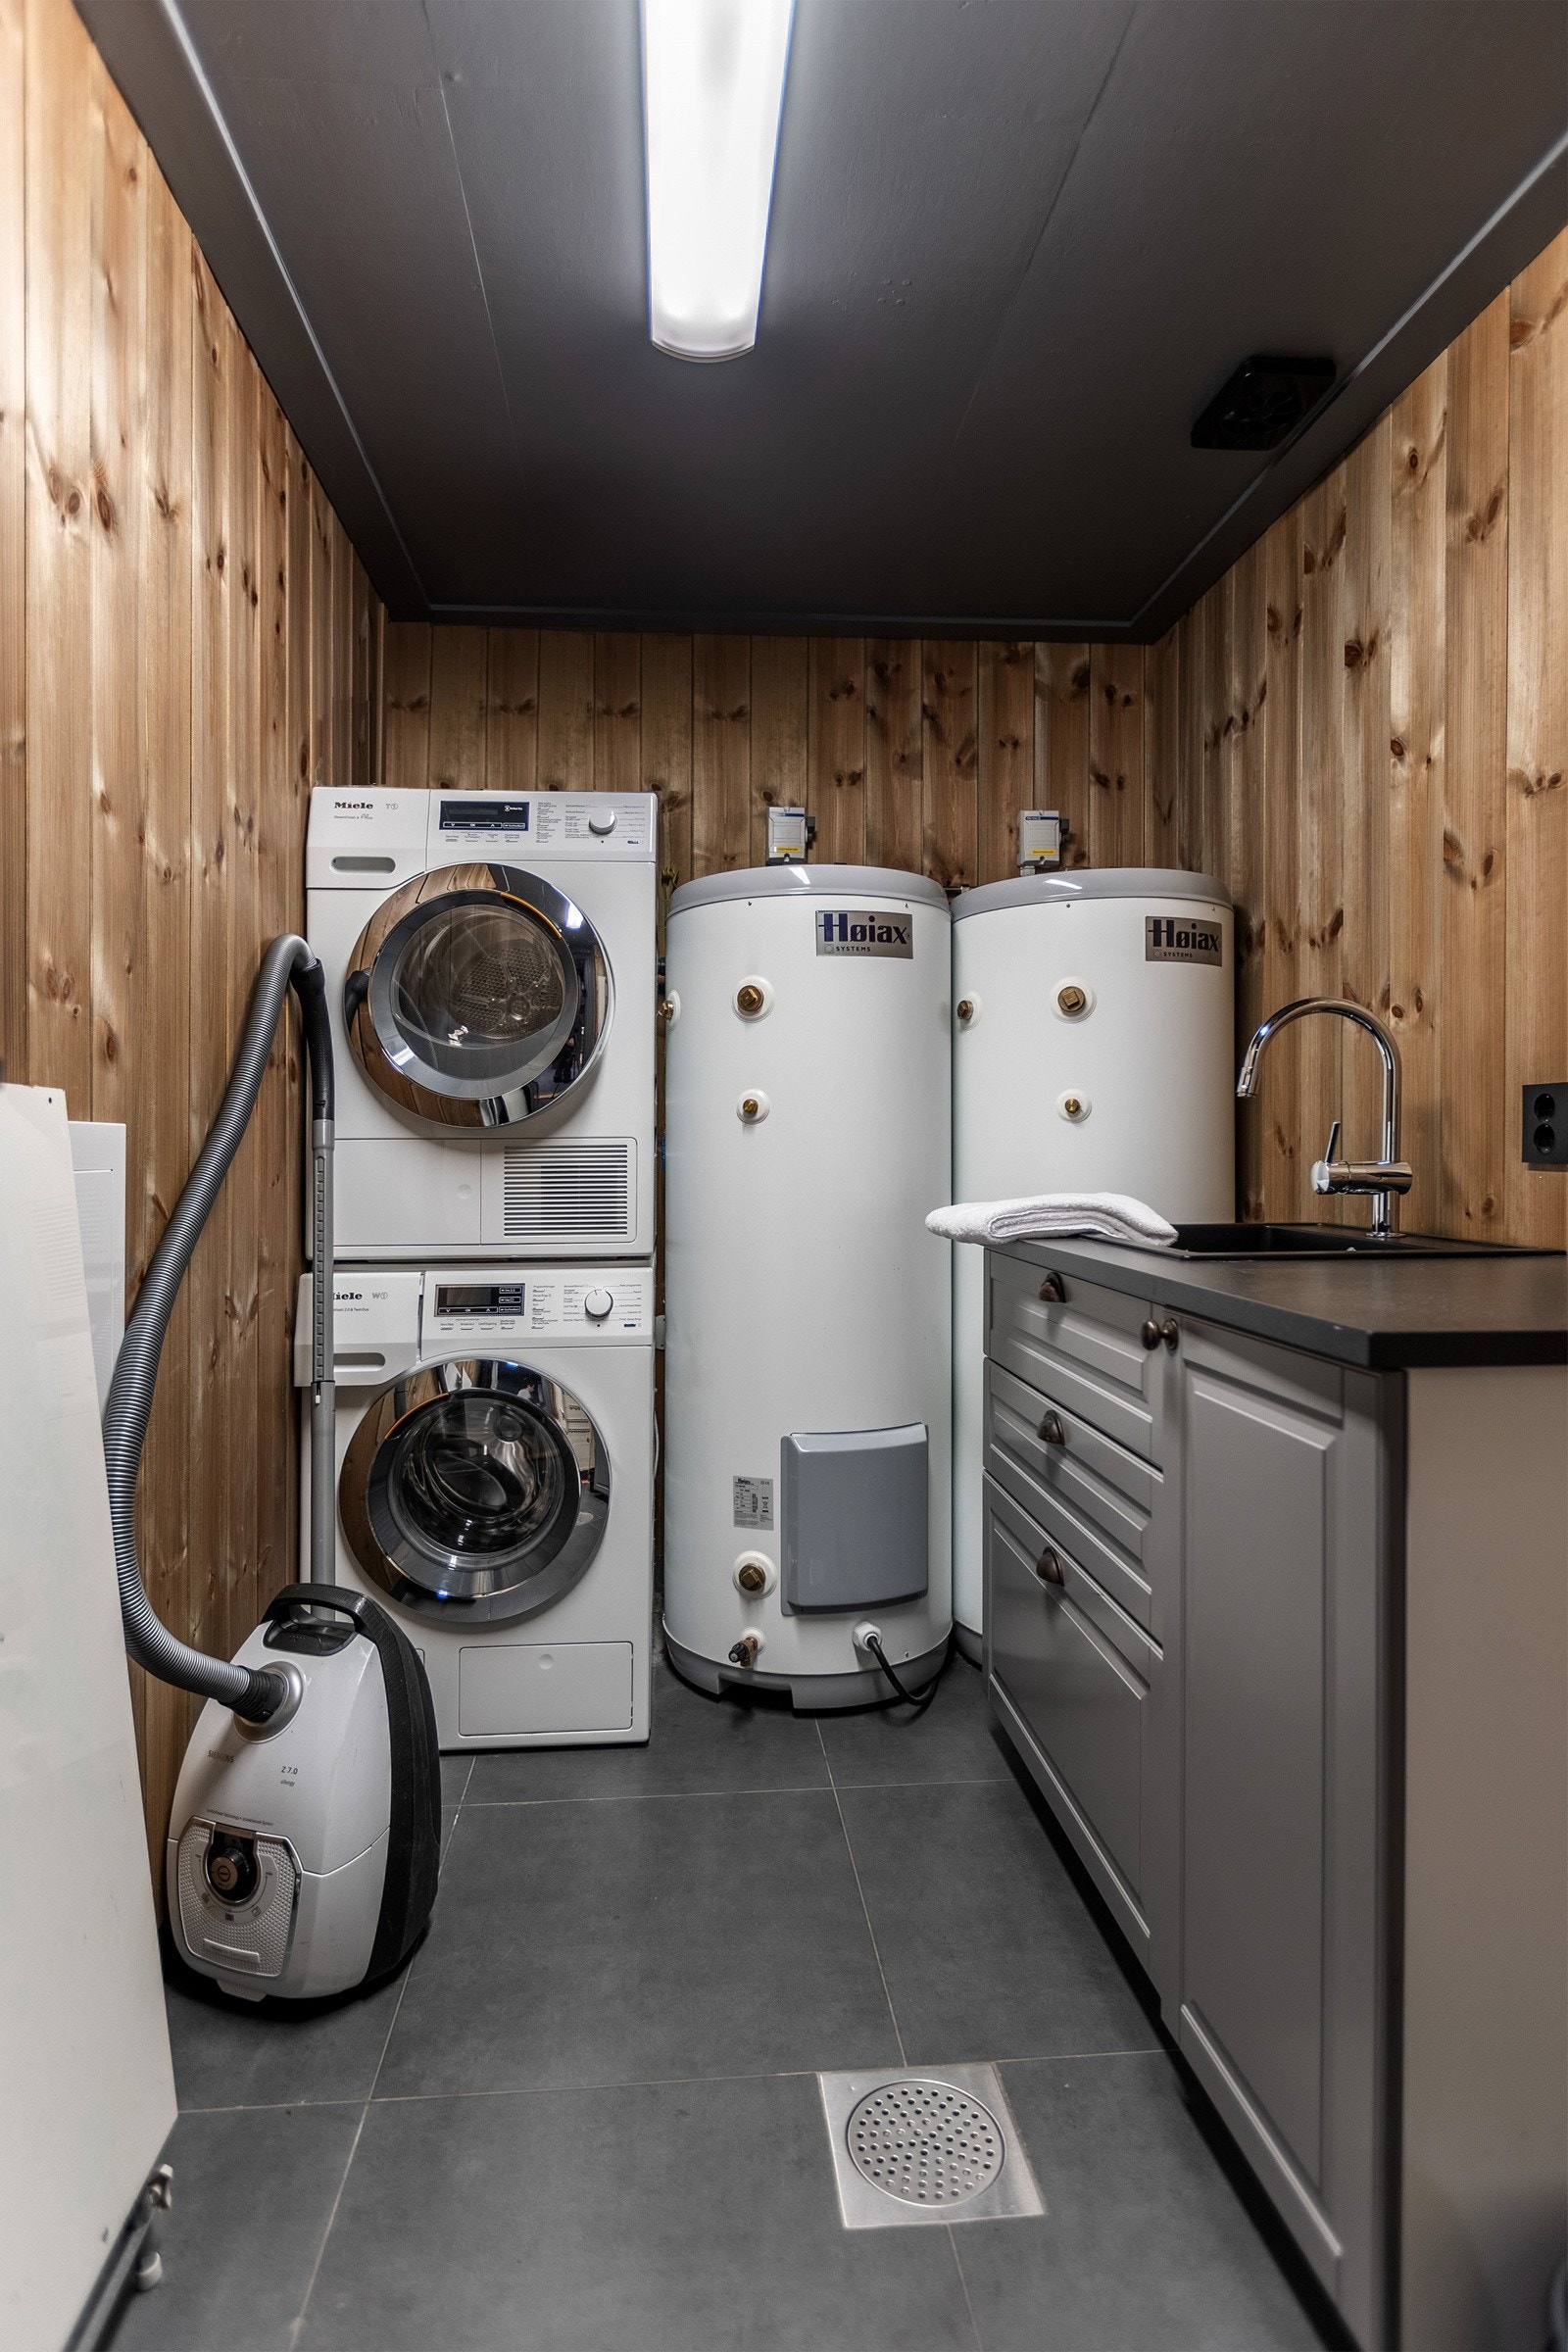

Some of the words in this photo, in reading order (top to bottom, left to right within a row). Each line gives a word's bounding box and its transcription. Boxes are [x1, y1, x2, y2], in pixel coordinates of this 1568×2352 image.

[818, 913, 907, 945] Høiax
[1148, 919, 1219, 952] Høiax
[207, 1749, 234, 1764] SIEENS
